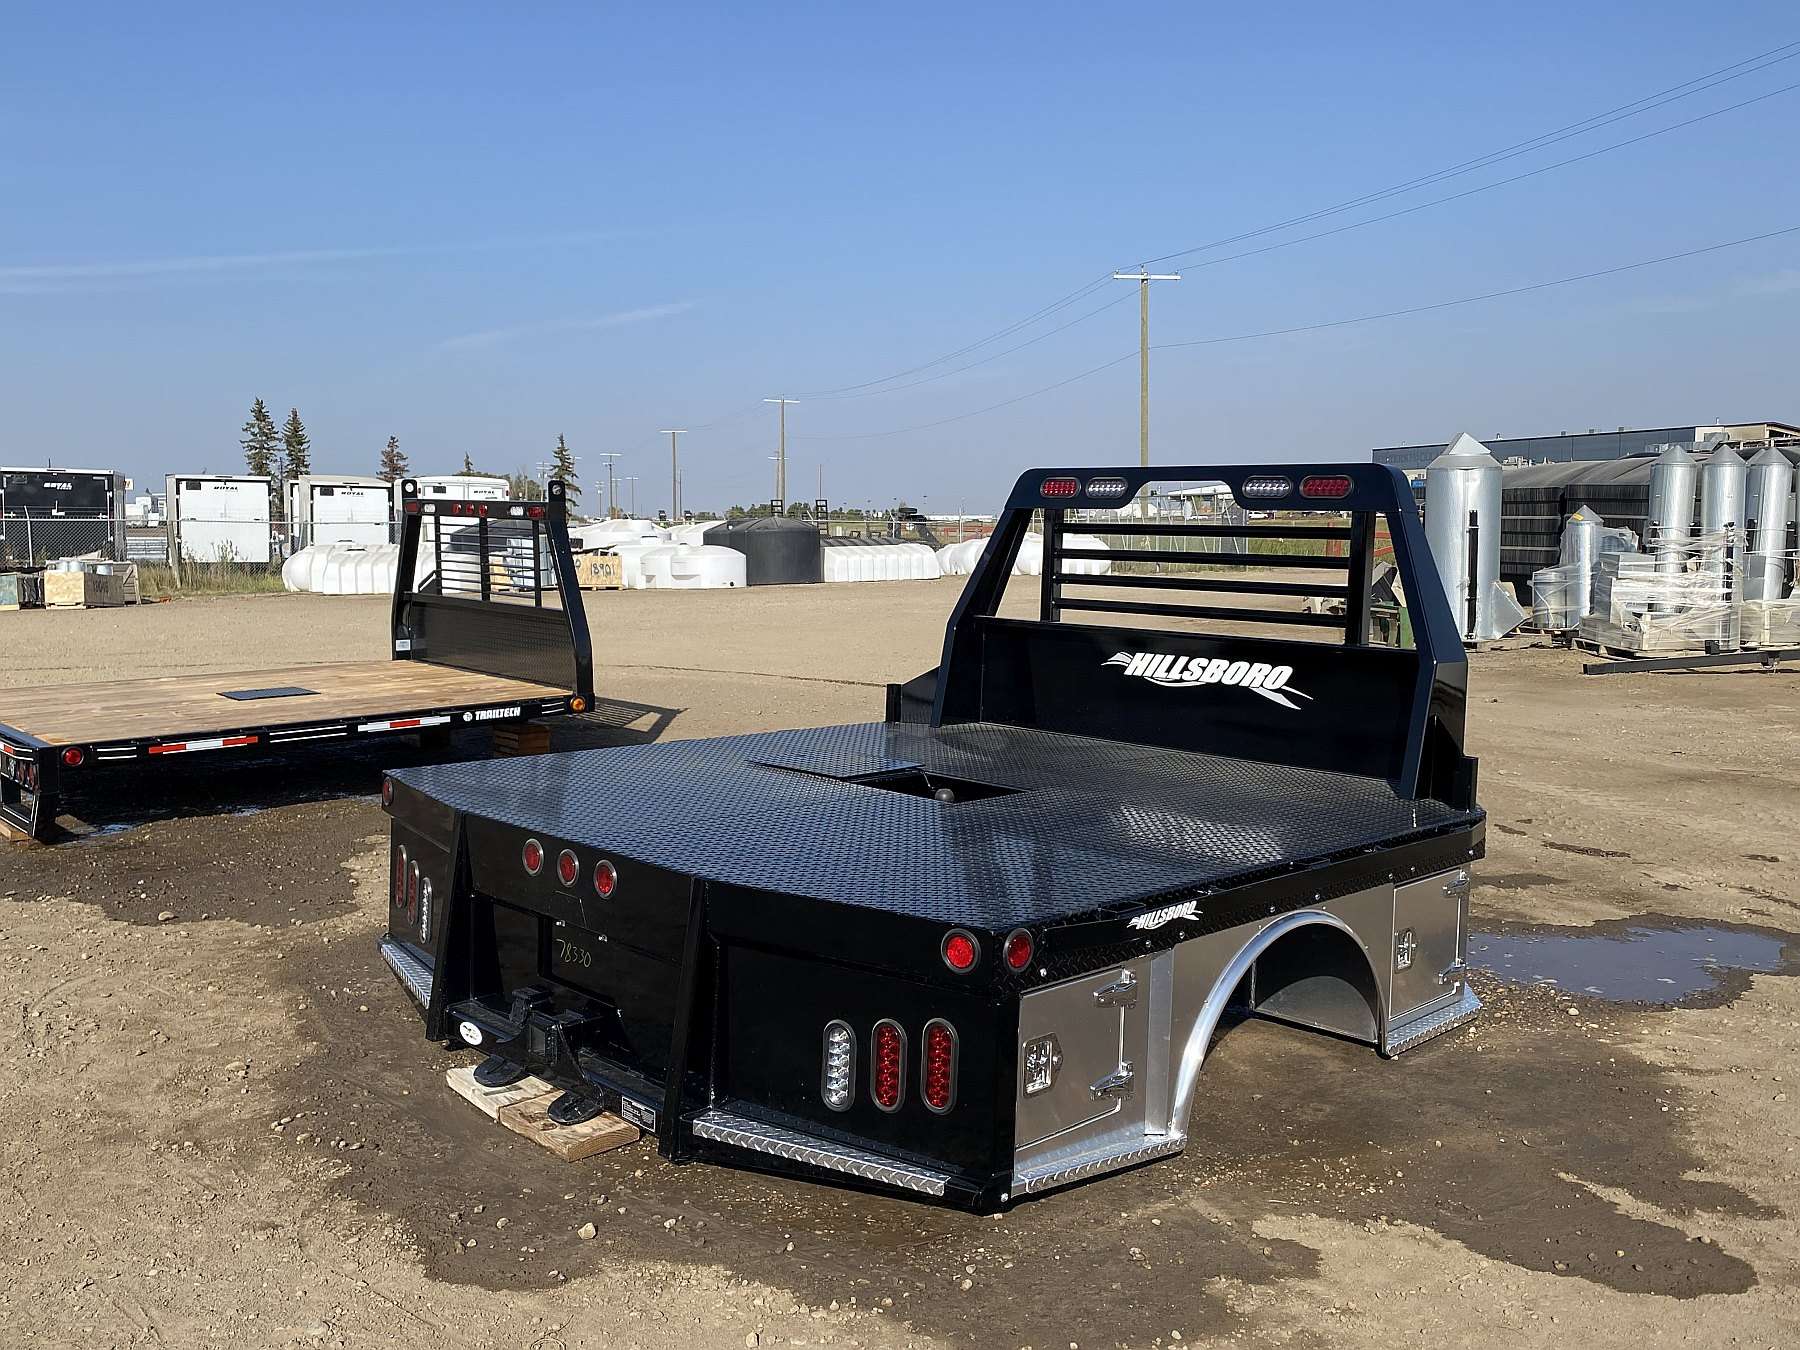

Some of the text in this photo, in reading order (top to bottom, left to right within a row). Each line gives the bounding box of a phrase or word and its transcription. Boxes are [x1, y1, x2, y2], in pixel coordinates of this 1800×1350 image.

[1122, 652, 1295, 691] HILLSBORO
[475, 706, 521, 720] TRAILTECH
[1134, 900, 1199, 930] HILLSBORO
[555, 938, 592, 968] 78330
